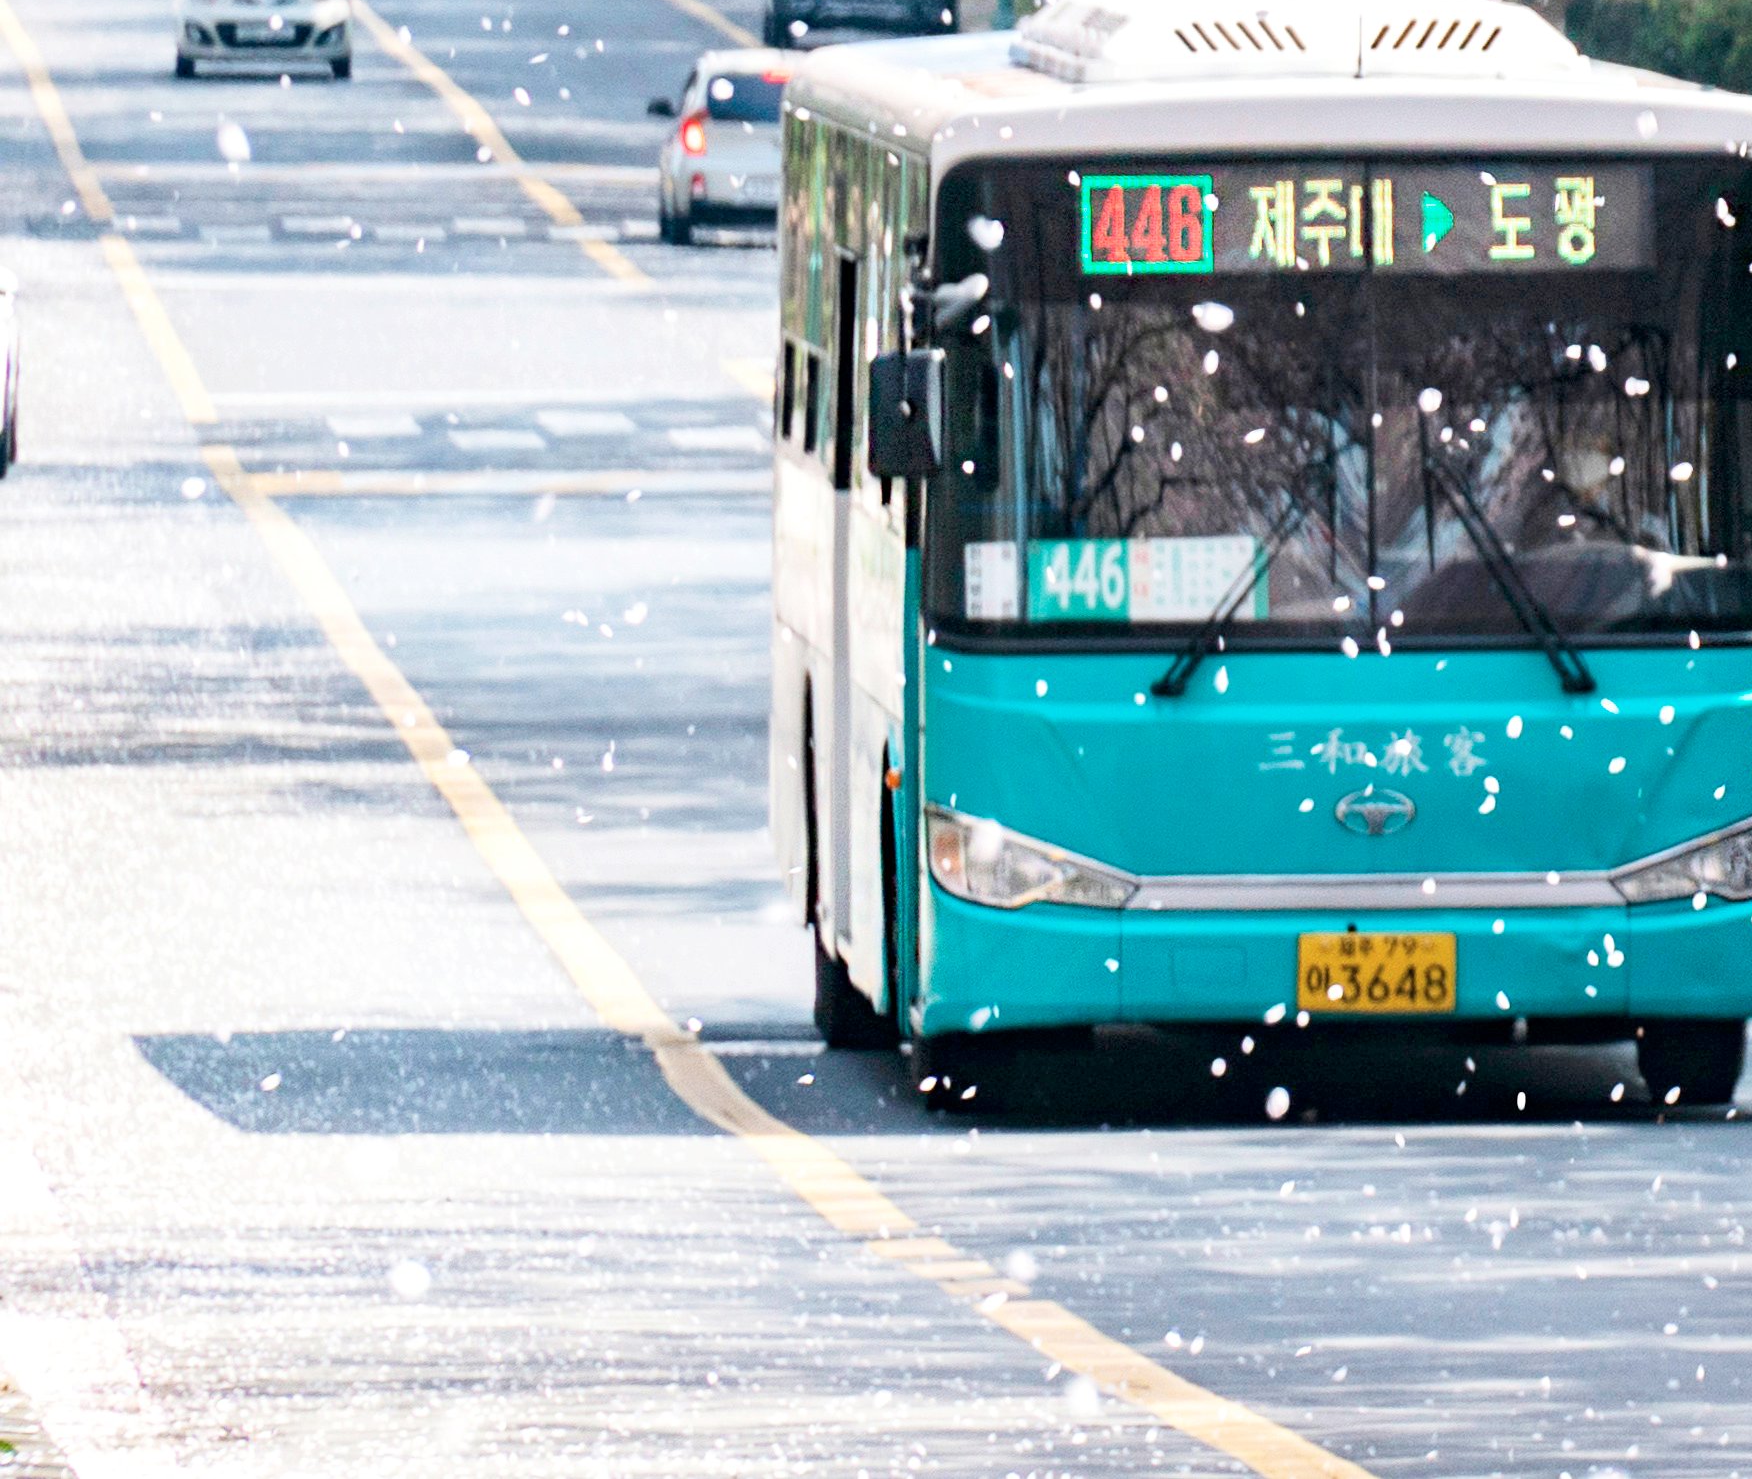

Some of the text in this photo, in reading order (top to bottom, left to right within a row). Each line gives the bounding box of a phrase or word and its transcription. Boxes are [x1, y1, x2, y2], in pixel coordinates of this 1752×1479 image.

[1092, 183, 1203, 262] 446
[1046, 541, 1126, 611] 446
[1384, 935, 1417, 958] 79
